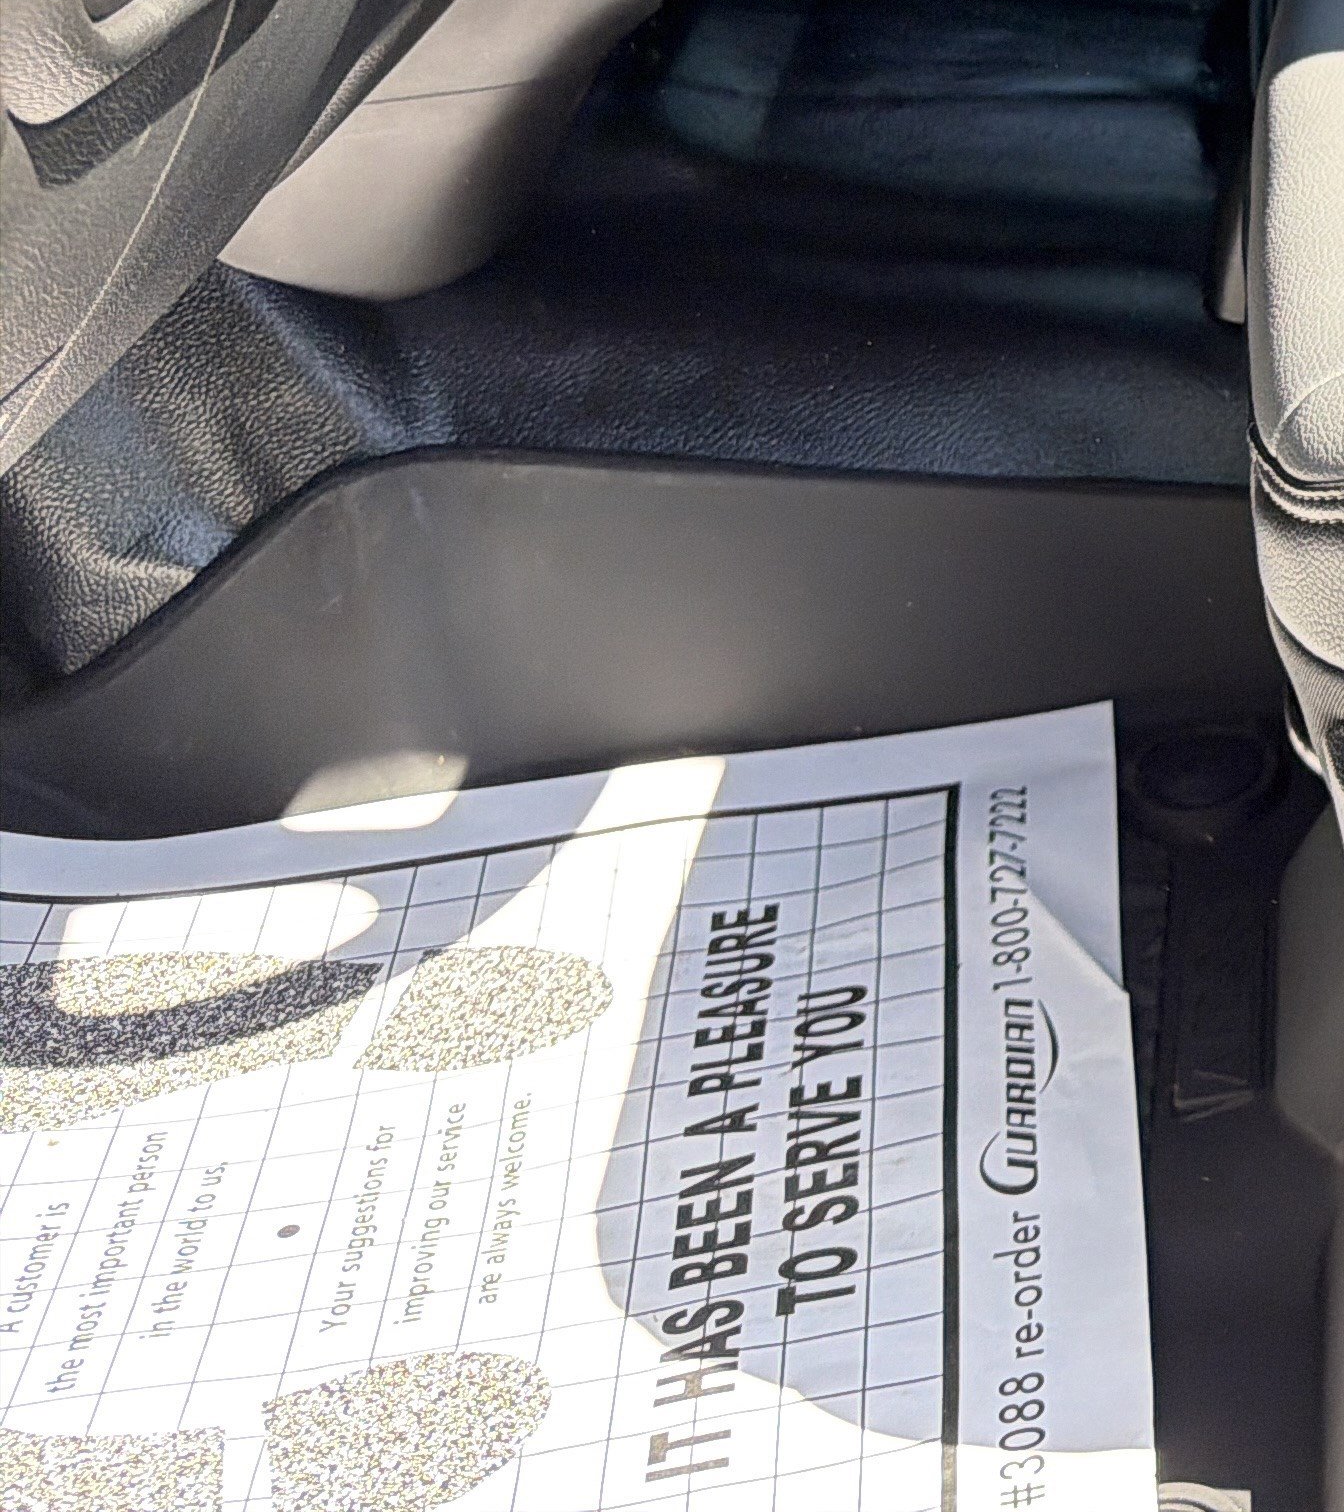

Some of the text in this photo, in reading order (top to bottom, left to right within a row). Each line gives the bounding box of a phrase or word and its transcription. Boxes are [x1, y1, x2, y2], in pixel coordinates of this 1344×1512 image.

[171, 1218, 208, 1275] world
[187, 1192, 217, 1214] to
[318, 1124, 396, 1334] Your suggestions for
[393, 1102, 466, 1325] improving our service
[478, 1092, 532, 1305] are always welcome.
[645, 902, 780, 1482] IT HAS BEEN A PLEASURE
[775, 984, 868, 1317] TO SERVE YOU
[979, 786, 1046, 1509] #3088 re-order GUARDIAN 1-800-727-7222
[7, 1224, 60, 1314] customer
[35, 1201, 70, 1219] is
[46, 1131, 168, 1394] the most important person
[139, 1319, 175, 1340] in
[153, 1280, 188, 1315] the
